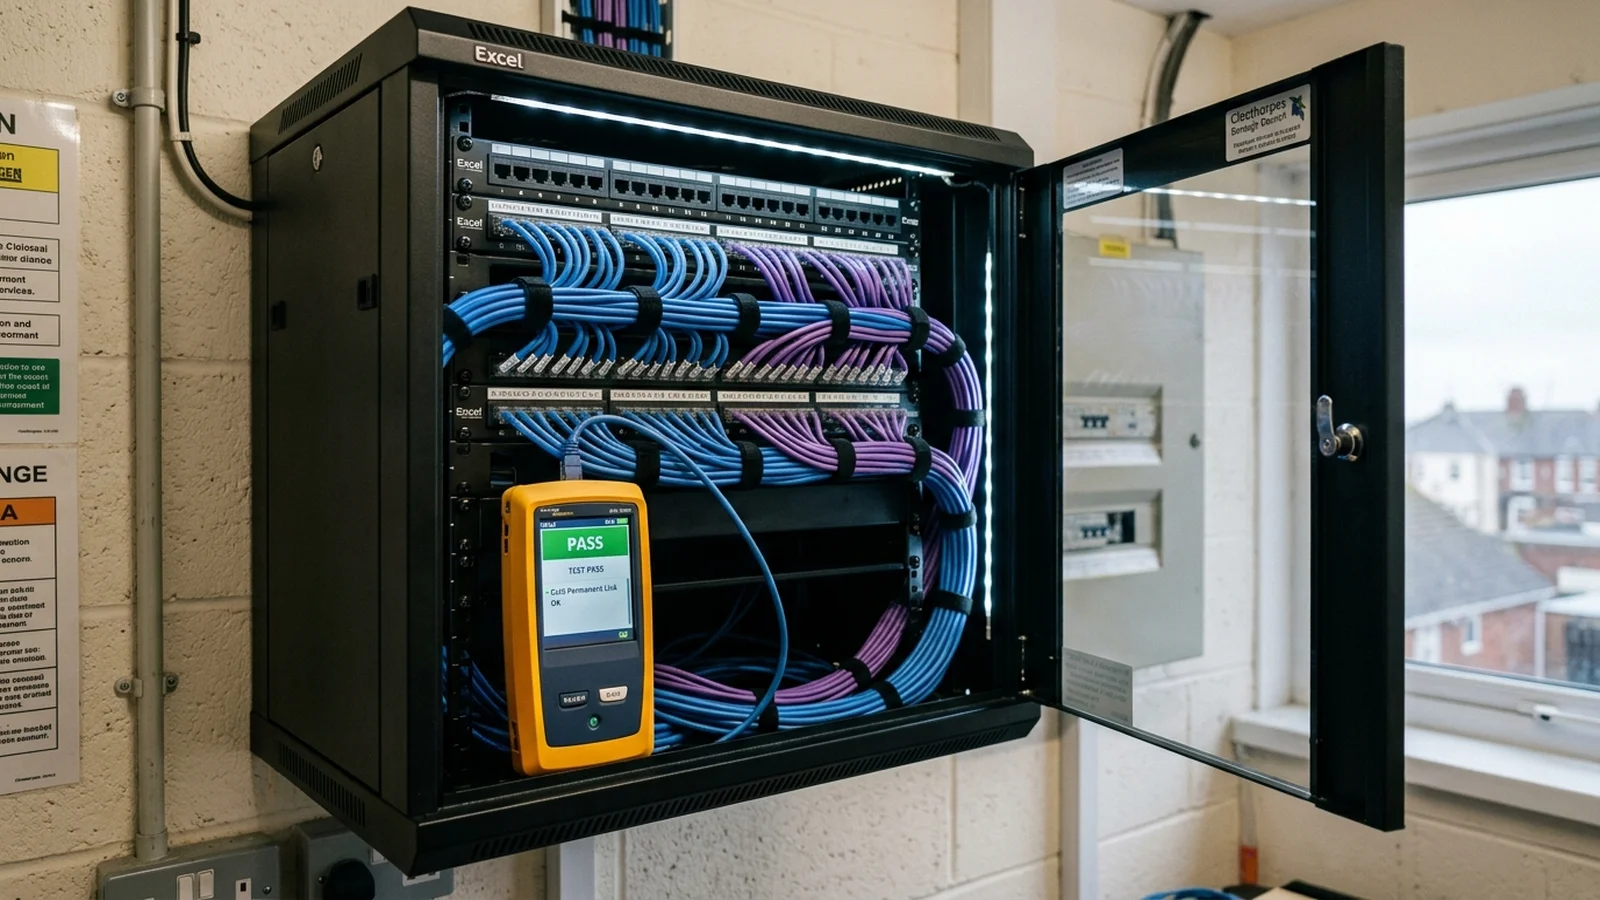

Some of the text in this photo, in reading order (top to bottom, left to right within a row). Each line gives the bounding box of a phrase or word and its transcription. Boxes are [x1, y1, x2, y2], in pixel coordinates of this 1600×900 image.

[474, 46, 523, 69] Excel
[457, 158, 483, 170] Excel
[14, 320, 31, 328] and
[0, 504, 18, 520] A
[567, 535, 604, 551] PASS
[587, 565, 605, 573] PASS
[567, 585, 603, 594] Permanent
